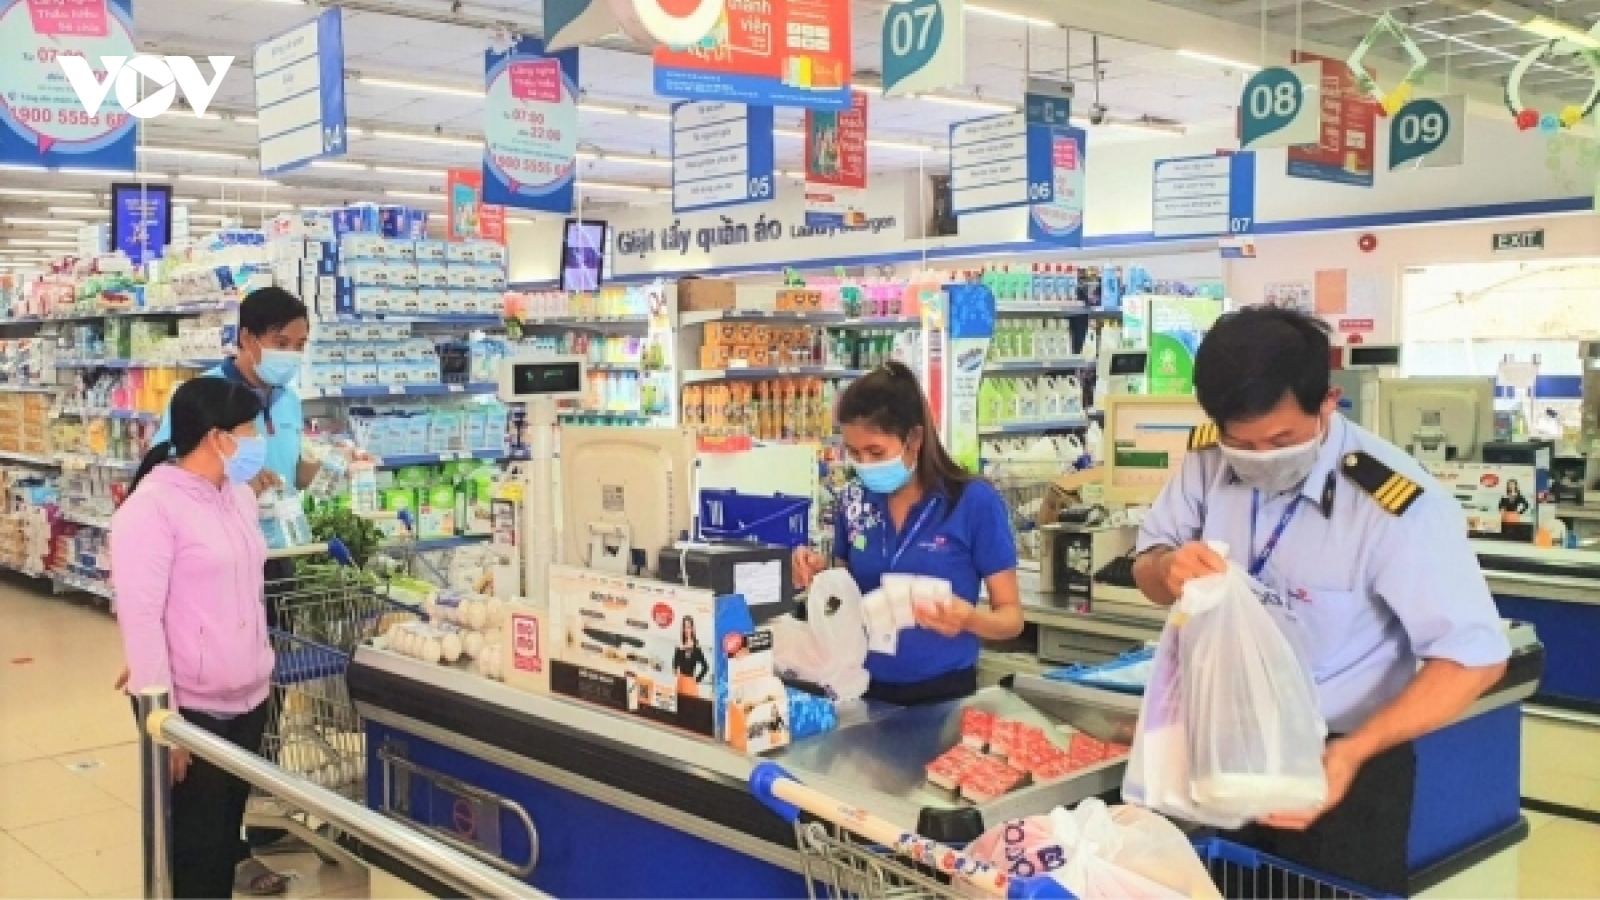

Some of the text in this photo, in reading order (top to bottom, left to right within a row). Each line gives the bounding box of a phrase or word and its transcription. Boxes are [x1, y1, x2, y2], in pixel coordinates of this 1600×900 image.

[891, 3, 937, 56] 07
[1251, 81, 1297, 120] 08
[324, 124, 342, 152] 04
[1400, 113, 1446, 145] 09
[750, 175, 770, 197] 05
[1029, 182, 1051, 200] 06
[616, 231, 656, 259] Giặt
[695, 214, 750, 254] quần
[754, 212, 783, 243] áo
[1231, 217, 1252, 232] 07
[1498, 232, 1537, 248] EXIT
